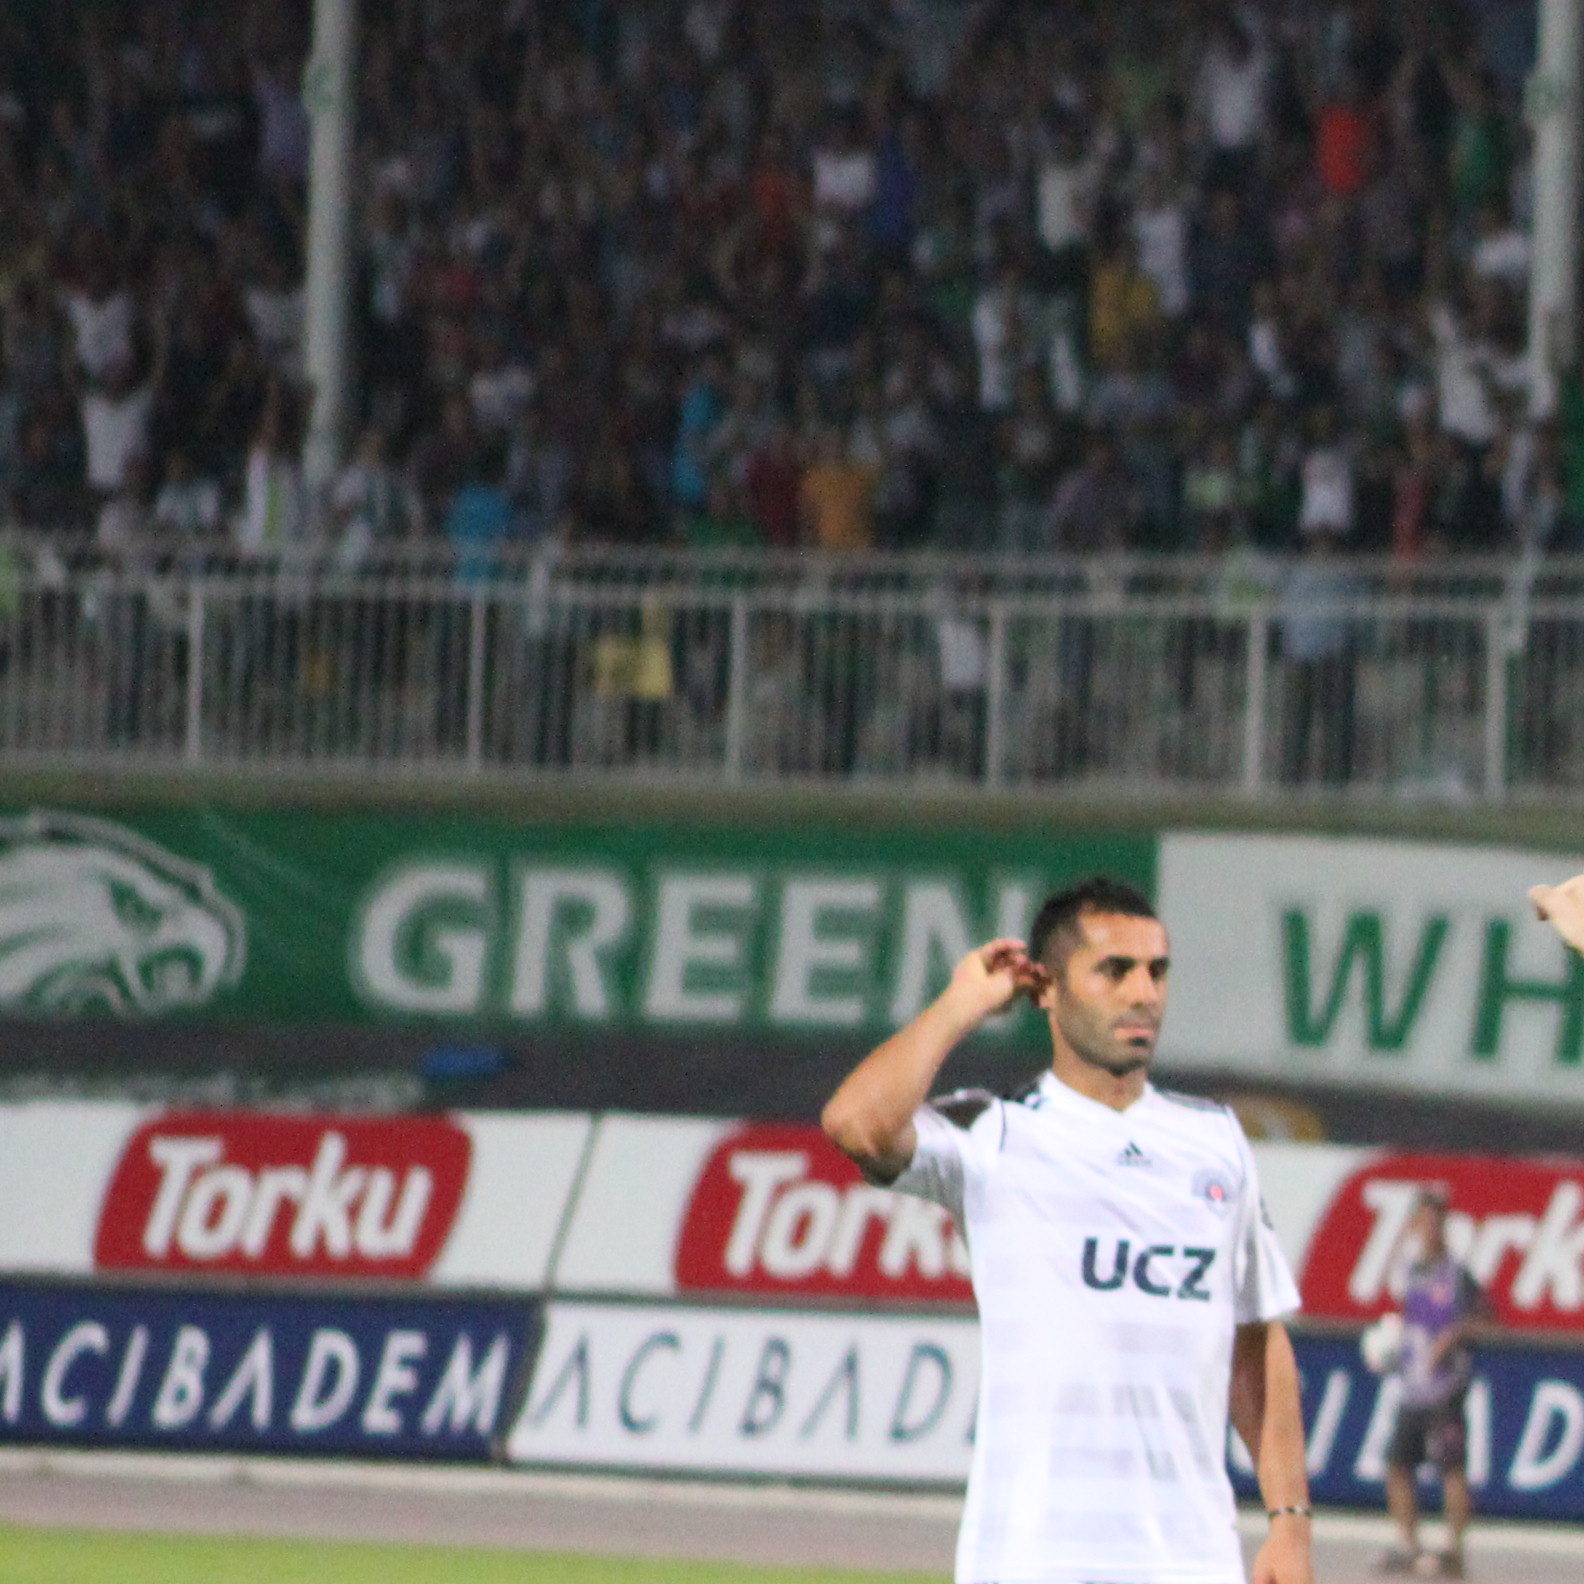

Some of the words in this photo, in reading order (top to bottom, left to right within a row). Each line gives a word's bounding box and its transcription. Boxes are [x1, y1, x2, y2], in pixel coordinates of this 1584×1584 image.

[352, 862, 1030, 1024] GREEN
[142, 1130, 432, 1261] Torku
[724, 1150, 972, 1279] Tork
[1082, 1236, 1217, 1301] UCZ
[532, 1328, 978, 1445] ACIBAD
